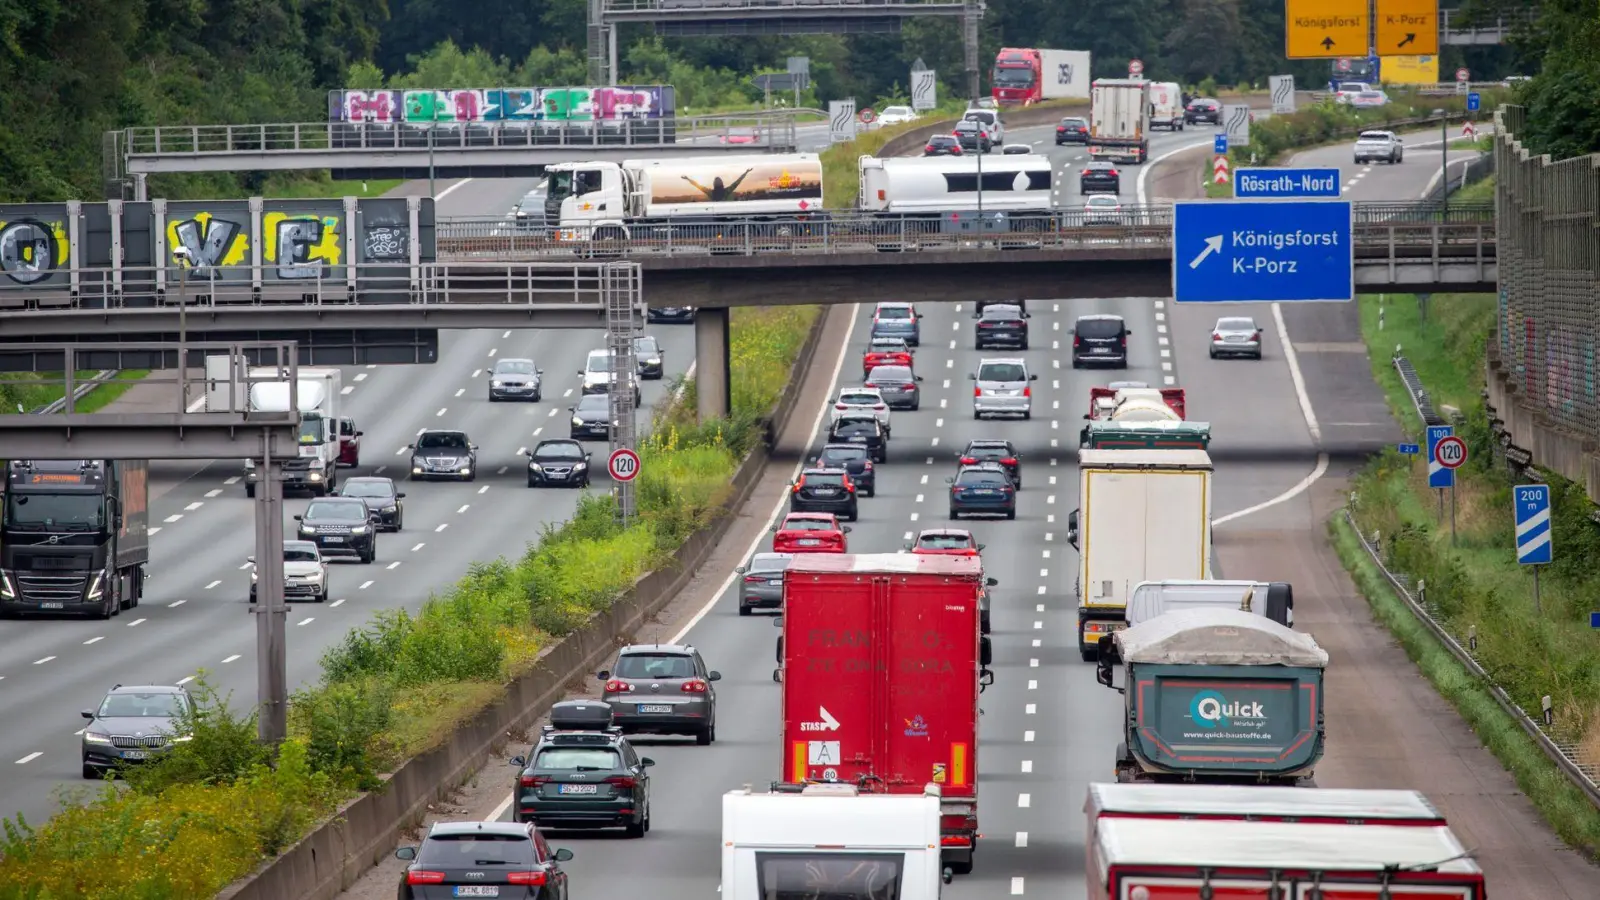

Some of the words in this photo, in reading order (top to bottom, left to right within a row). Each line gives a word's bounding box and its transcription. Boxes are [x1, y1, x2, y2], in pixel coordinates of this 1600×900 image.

[1295, 16, 1360, 30] Königsforst
[1386, 14, 1428, 25] K-Porz
[1241, 174, 1334, 192] Rösrath-Nord
[1232, 230, 1338, 250] Königsforst
[1232, 257, 1297, 274] K-Porz
[1441, 444, 1461, 459] 120
[615, 458, 634, 472] 120
[1521, 490, 1542, 501] 200
[1527, 502, 1537, 510] m
[1198, 697, 1264, 720] Quick
[800, 722, 821, 732] STAS
[1183, 731, 1272, 740] www.quick-baustoffe.de
[817, 744, 832, 761] A
[824, 771, 836, 780] 80
